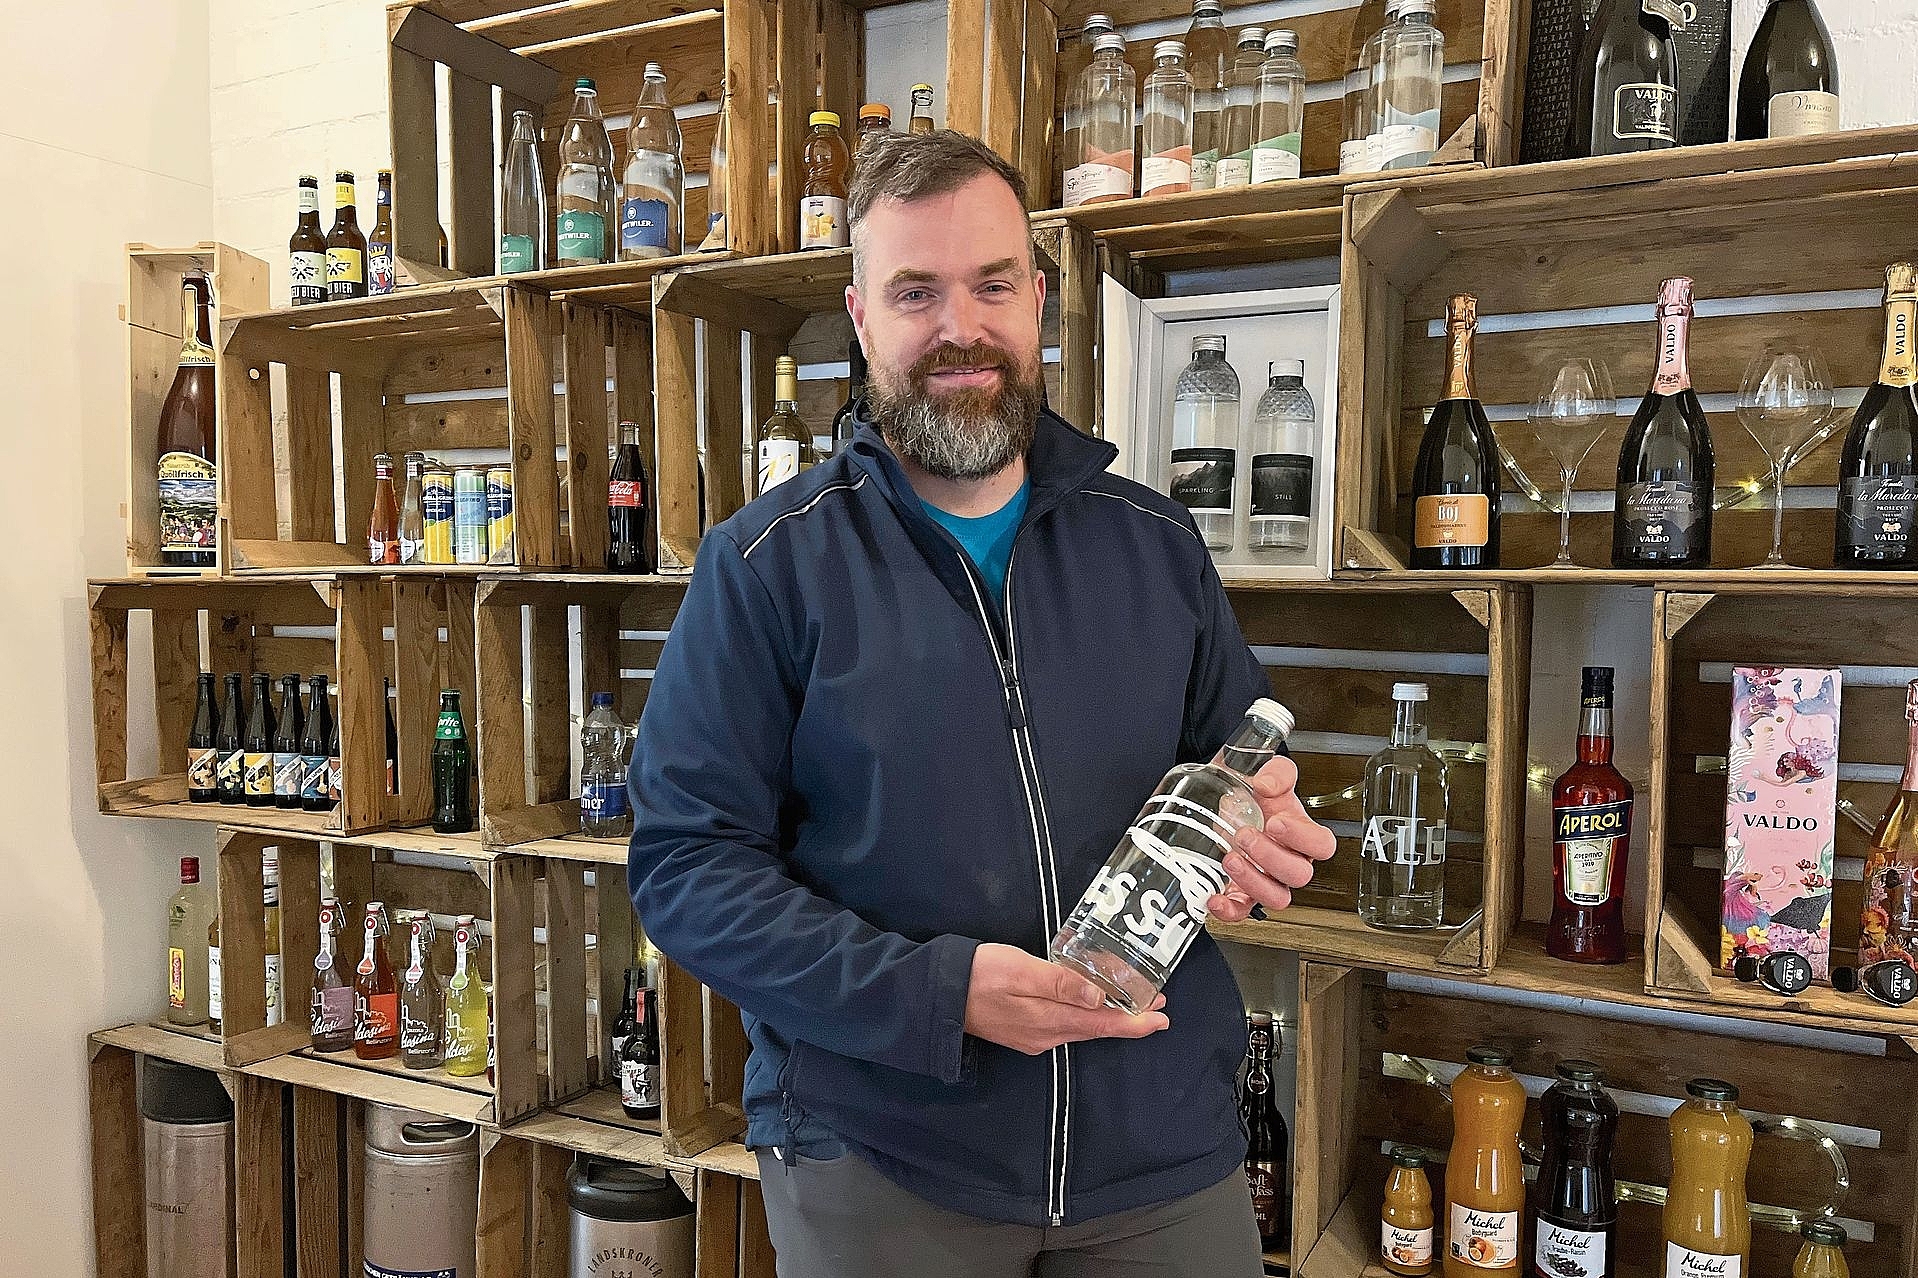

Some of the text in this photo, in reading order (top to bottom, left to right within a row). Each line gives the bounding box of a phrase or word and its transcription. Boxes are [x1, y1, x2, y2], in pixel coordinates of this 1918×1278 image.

[302, 286, 321, 298] BIER
[334, 282, 353, 294] BIER
[1665, 323, 1676, 364] VALDO
[1895, 313, 1906, 356] VALDO
[1454, 333, 1463, 368] VALDO
[1438, 505, 1459, 523] BOJ
[1639, 535, 1670, 543] VALDO
[1874, 533, 1908, 542] VALDO
[1559, 811, 1623, 836] APEROL
[1742, 813, 1819, 832] VALDO
[1784, 957, 1796, 989] VALDO
[1892, 967, 1904, 999] VALDO
[1464, 1210, 1506, 1230] Michel
[1390, 1229, 1418, 1243] Michel
[1547, 1227, 1591, 1249] Michel
[587, 1247, 665, 1278] LANDSKRONER
[1680, 1251, 1728, 1274] Michel
